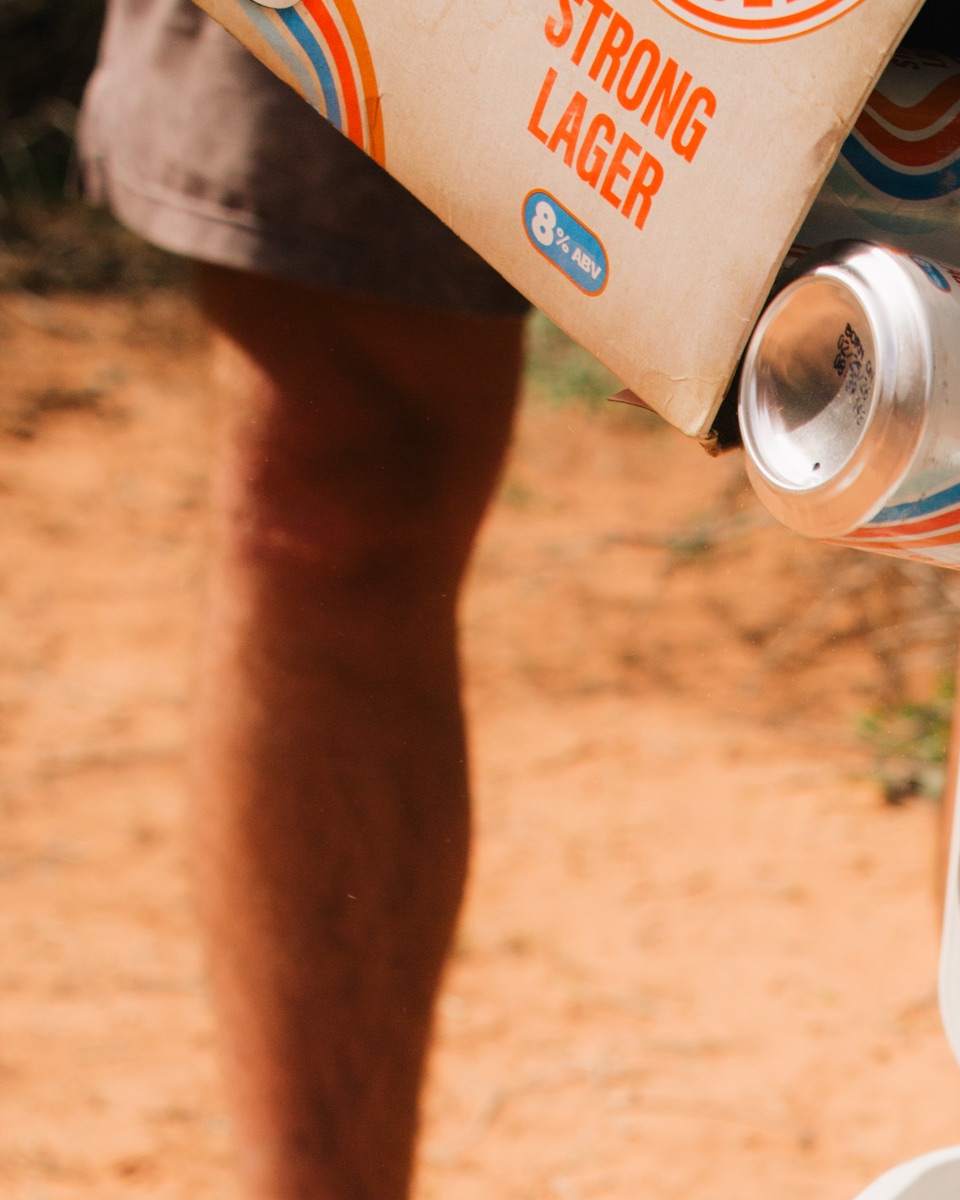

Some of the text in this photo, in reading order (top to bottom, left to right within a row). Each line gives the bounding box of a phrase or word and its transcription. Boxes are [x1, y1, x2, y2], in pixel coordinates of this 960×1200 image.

[527, 67, 664, 231] LAGER
[544, 0, 717, 163] STRONG
[531, 201, 602, 280] 8% ABV
